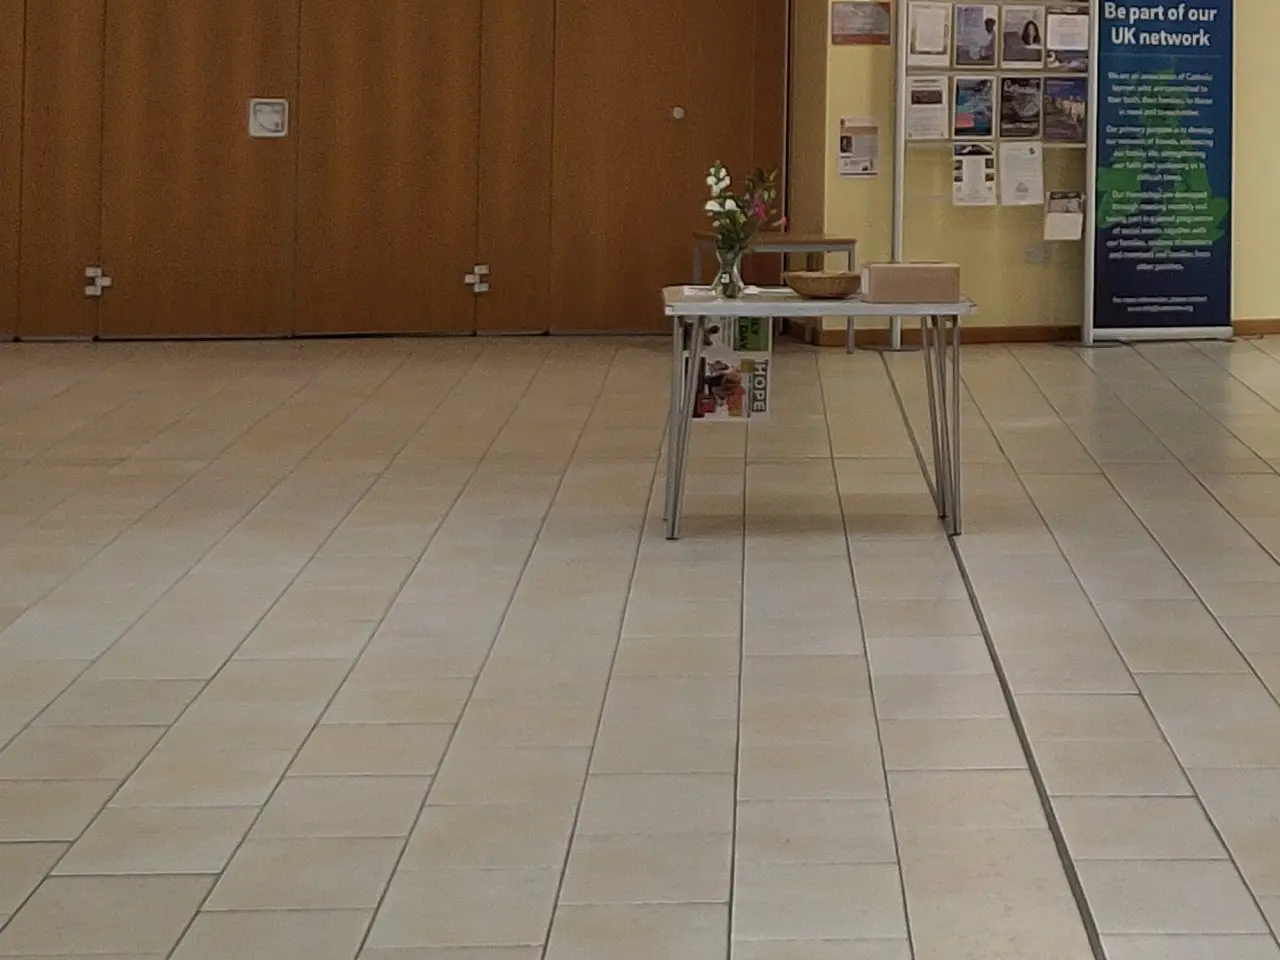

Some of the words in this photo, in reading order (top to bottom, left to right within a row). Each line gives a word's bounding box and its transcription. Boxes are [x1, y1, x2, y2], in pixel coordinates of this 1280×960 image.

[1104, 1, 1127, 20] Be
[1129, 5, 1164, 24] part
[1167, 3, 1185, 21] of
[1188, 8, 1218, 22] our
[1111, 27, 1136, 45] UK
[1139, 29, 1210, 46] network
[753, 363, 768, 411] HOPE
